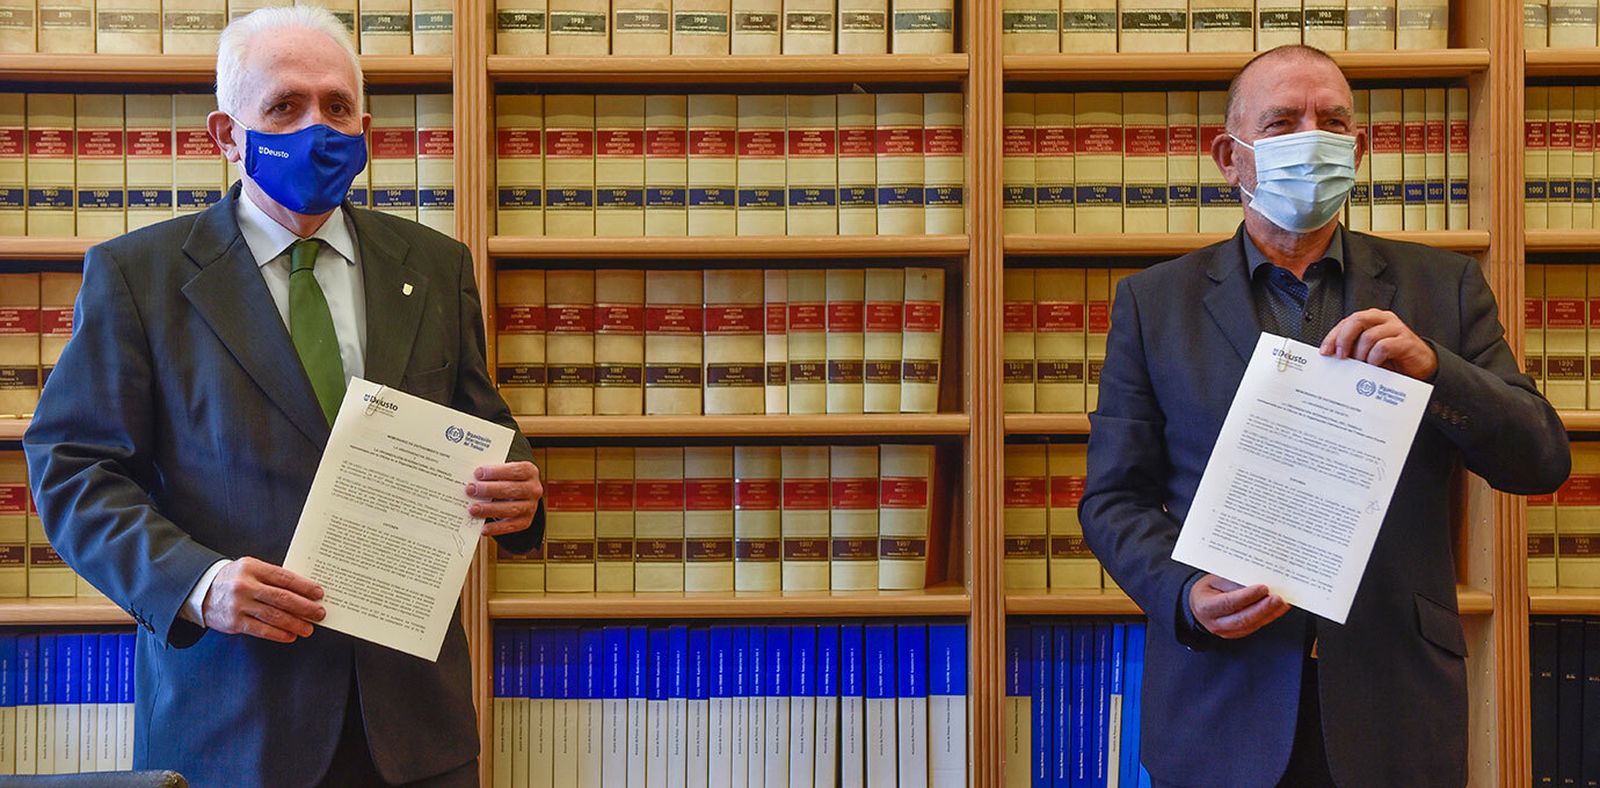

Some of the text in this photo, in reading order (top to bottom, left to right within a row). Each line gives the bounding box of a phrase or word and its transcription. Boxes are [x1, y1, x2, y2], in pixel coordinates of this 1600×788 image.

[264, 146, 289, 159] Deusto
[1279, 349, 1307, 365] Deusto
[370, 396, 398, 411] Deusto
